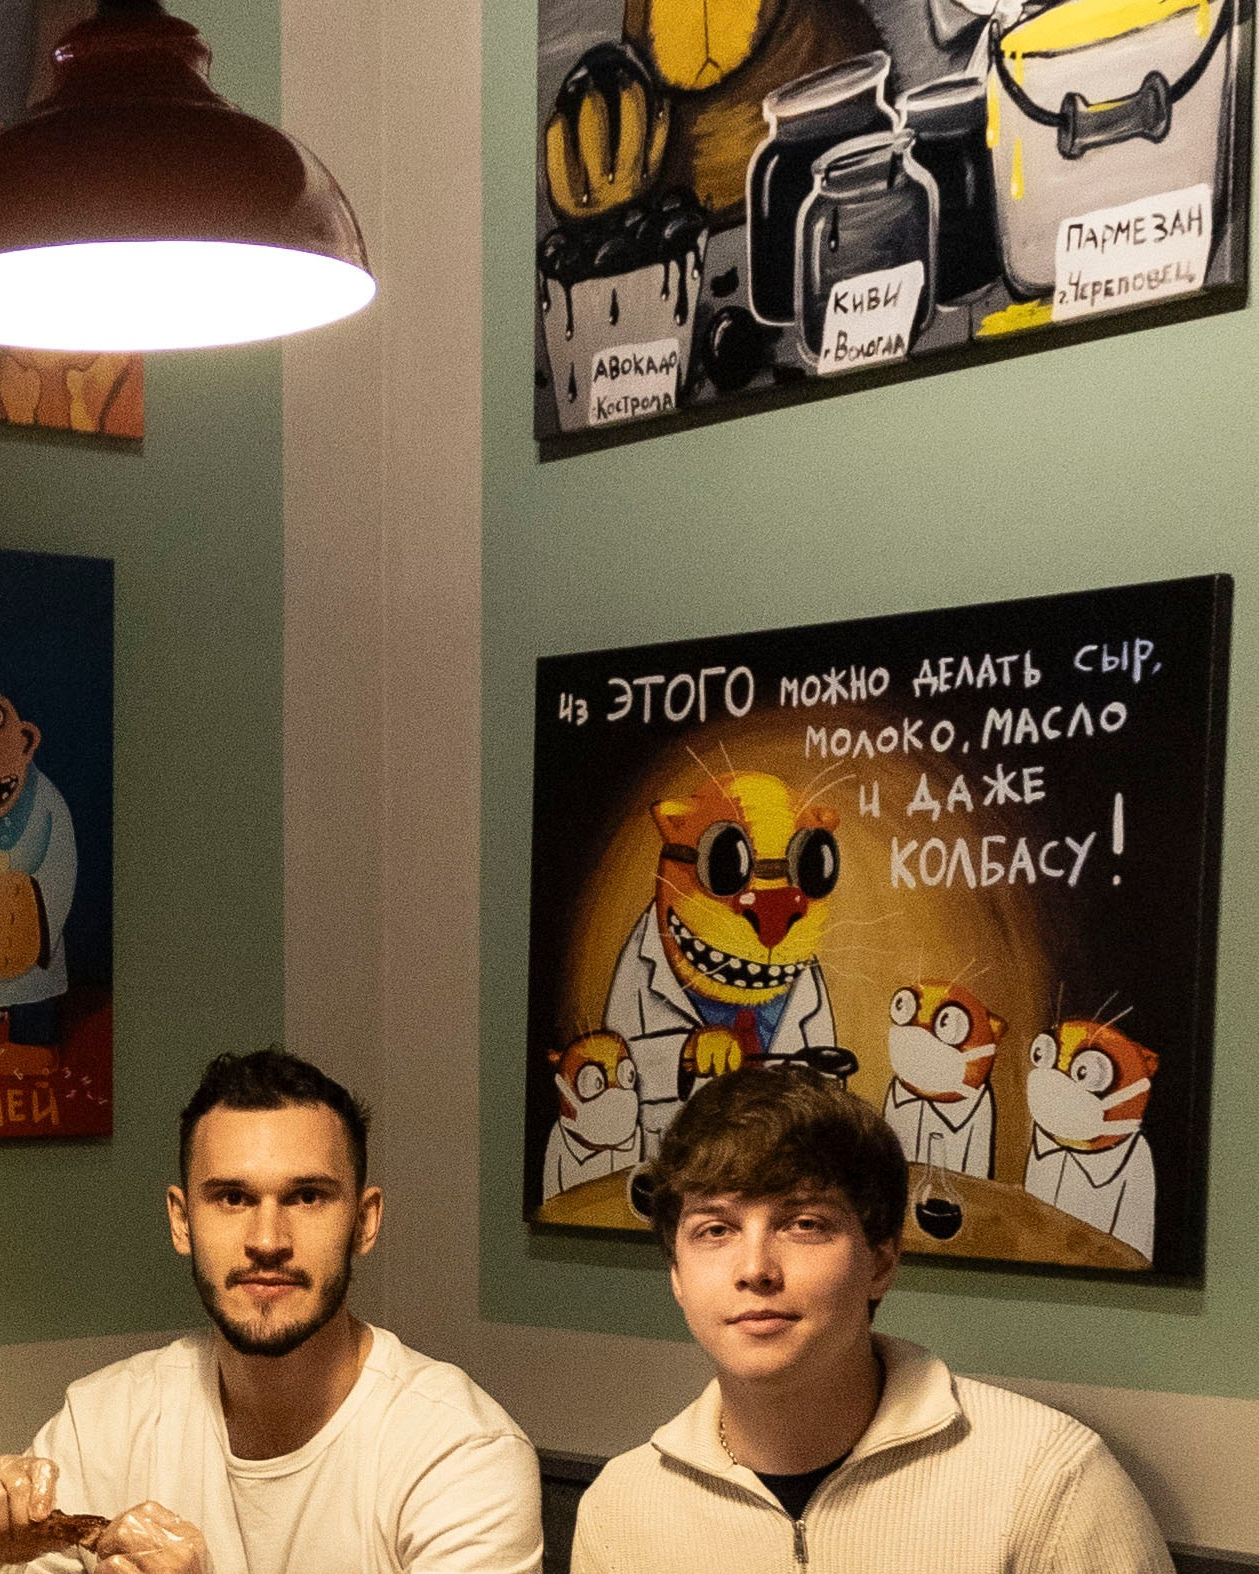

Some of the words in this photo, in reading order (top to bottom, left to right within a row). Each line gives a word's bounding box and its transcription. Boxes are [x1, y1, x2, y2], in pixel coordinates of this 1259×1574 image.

[1066, 203, 1203, 254] ПАРМЕЗАН
[833, 280, 903, 315] КИВИ
[592, 350, 678, 382] АВОКАДО
[606, 665, 756, 724] ЭТОГО
[778, 665, 892, 709] МОЖНО
[913, 650, 1043, 699] ДЕЛАТЬ
[1073, 636, 1163, 684] СЫР,
[980, 700, 1129, 751] МАСЛО
[906, 763, 1047, 822] ДАЖЕ
